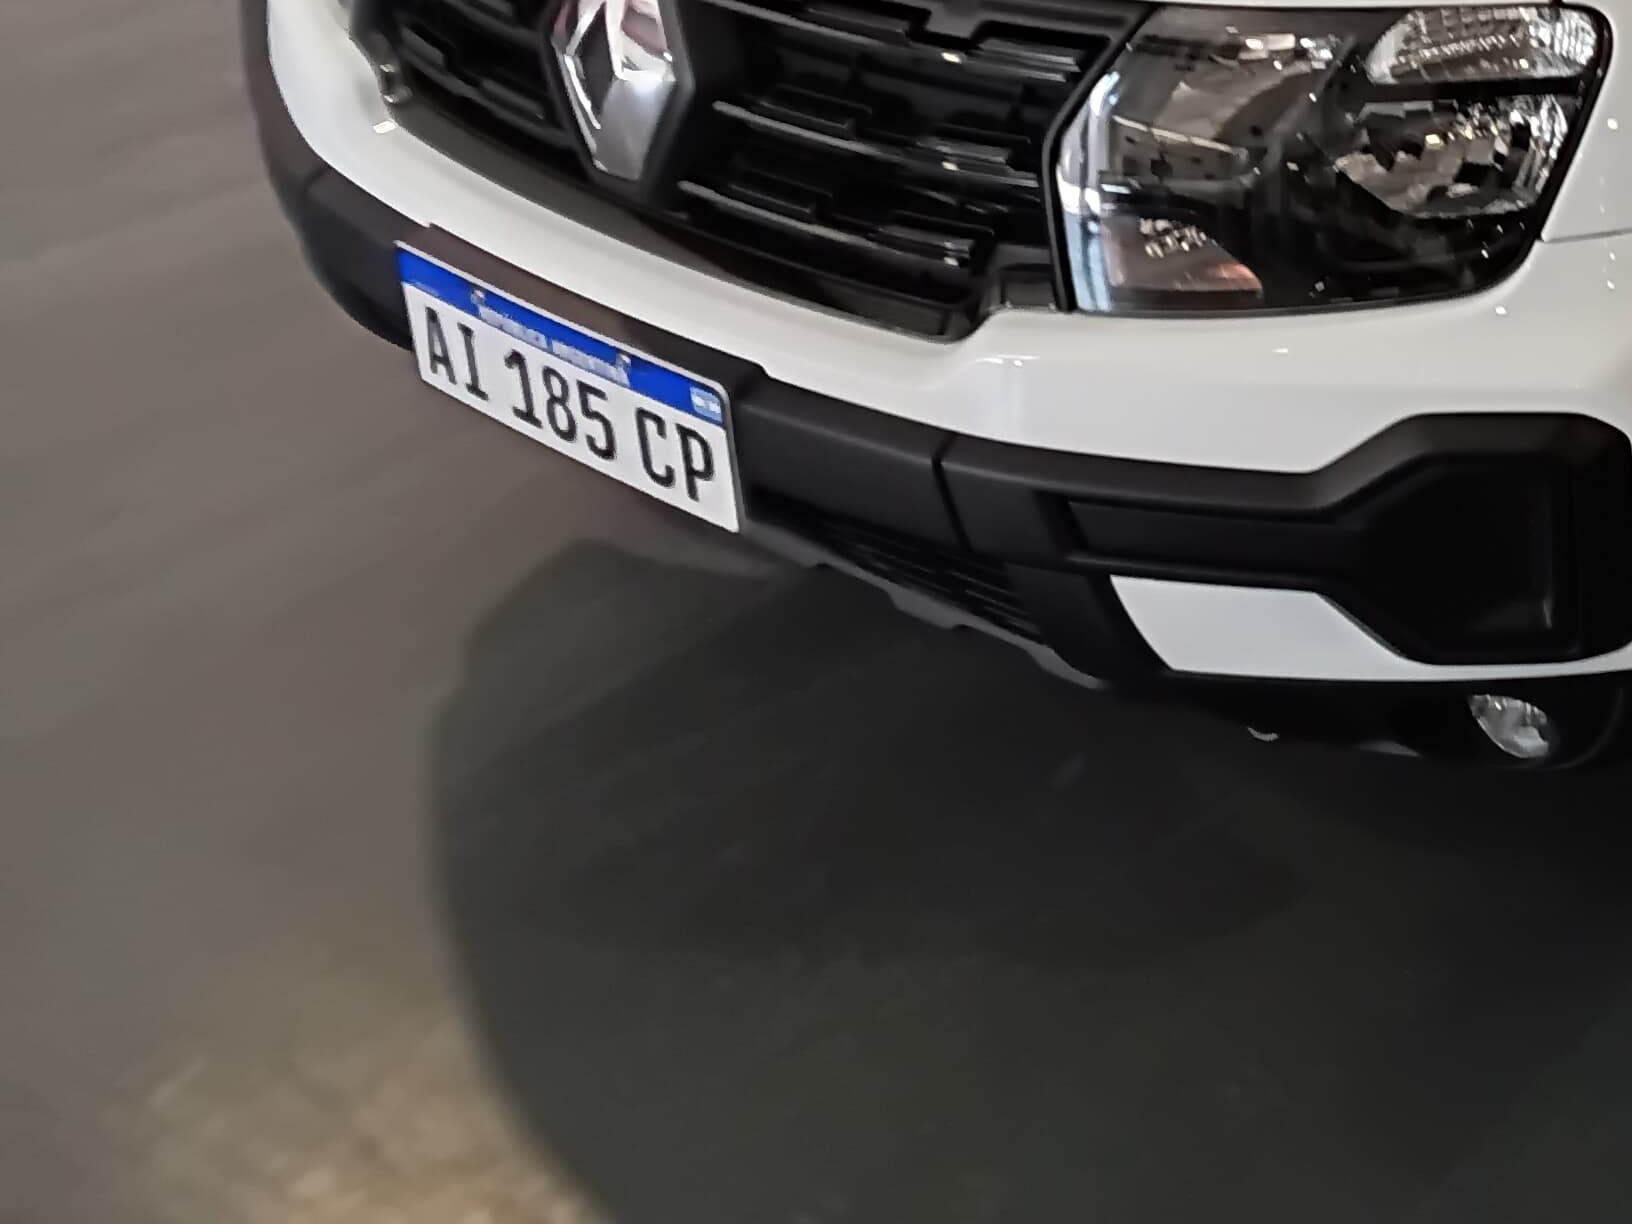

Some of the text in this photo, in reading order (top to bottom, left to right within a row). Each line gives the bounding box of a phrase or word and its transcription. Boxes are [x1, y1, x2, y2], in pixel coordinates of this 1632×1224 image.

[425, 306, 489, 400] AI
[504, 349, 617, 461] 185
[635, 406, 714, 502] CP
